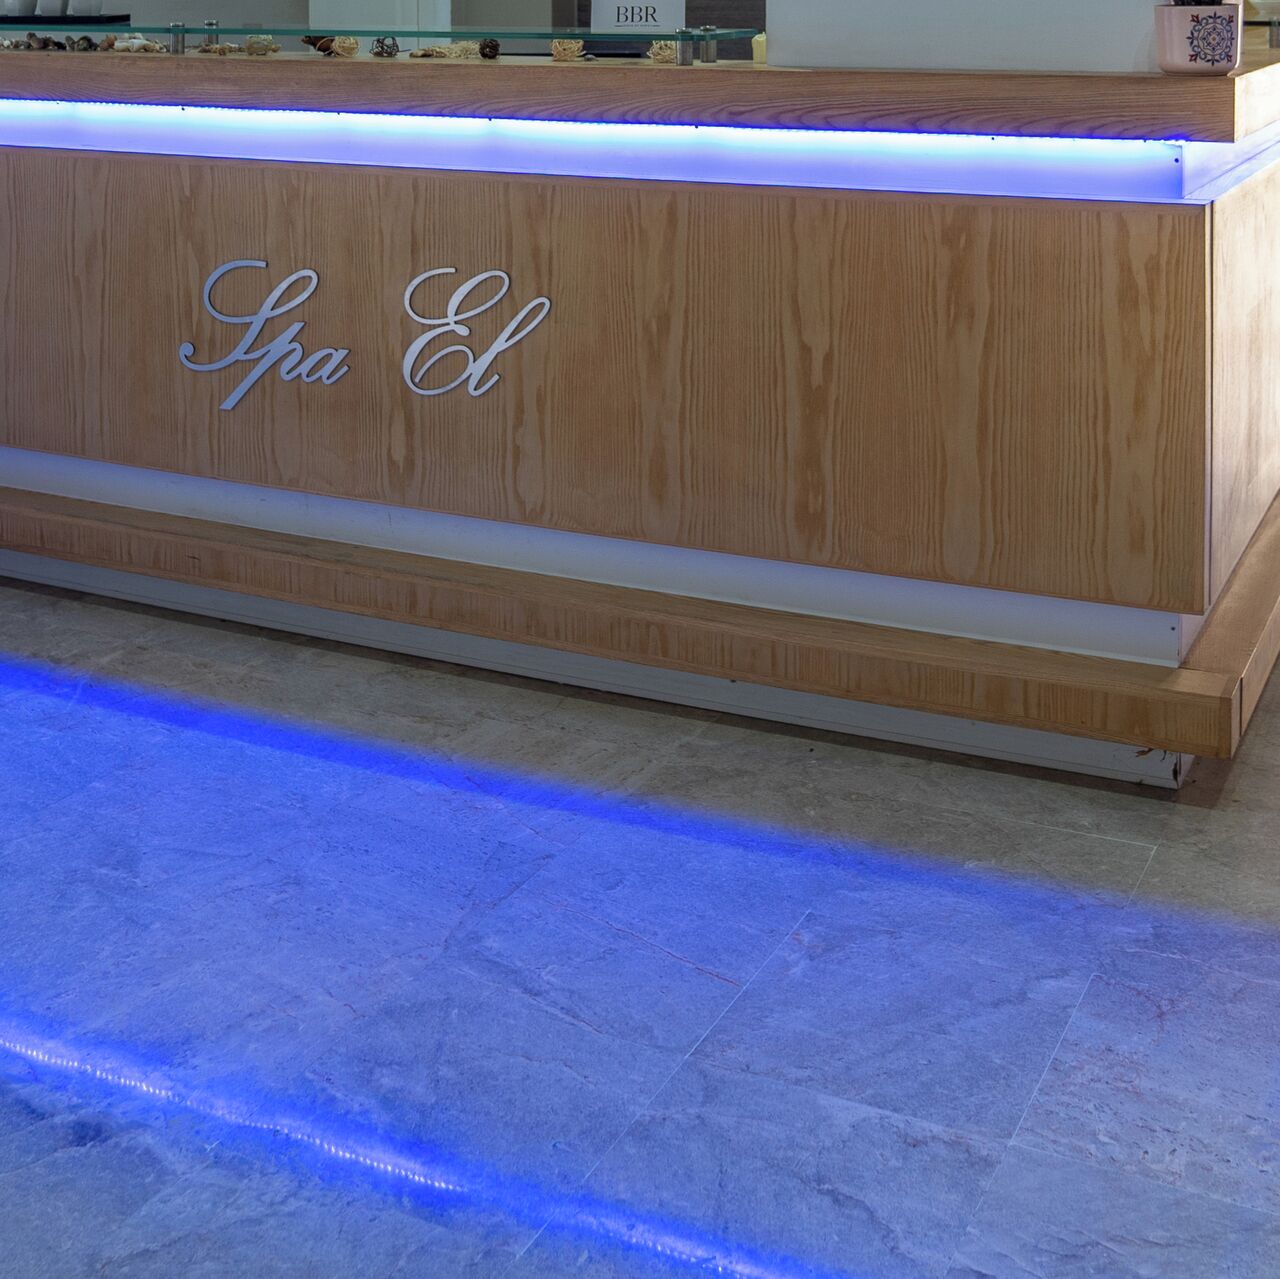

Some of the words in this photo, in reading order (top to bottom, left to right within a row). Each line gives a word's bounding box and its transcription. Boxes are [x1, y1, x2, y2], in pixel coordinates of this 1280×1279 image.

[616, 5, 658, 23] BBR
[178, 258, 351, 411] Spa
[402, 266, 552, 397] El
